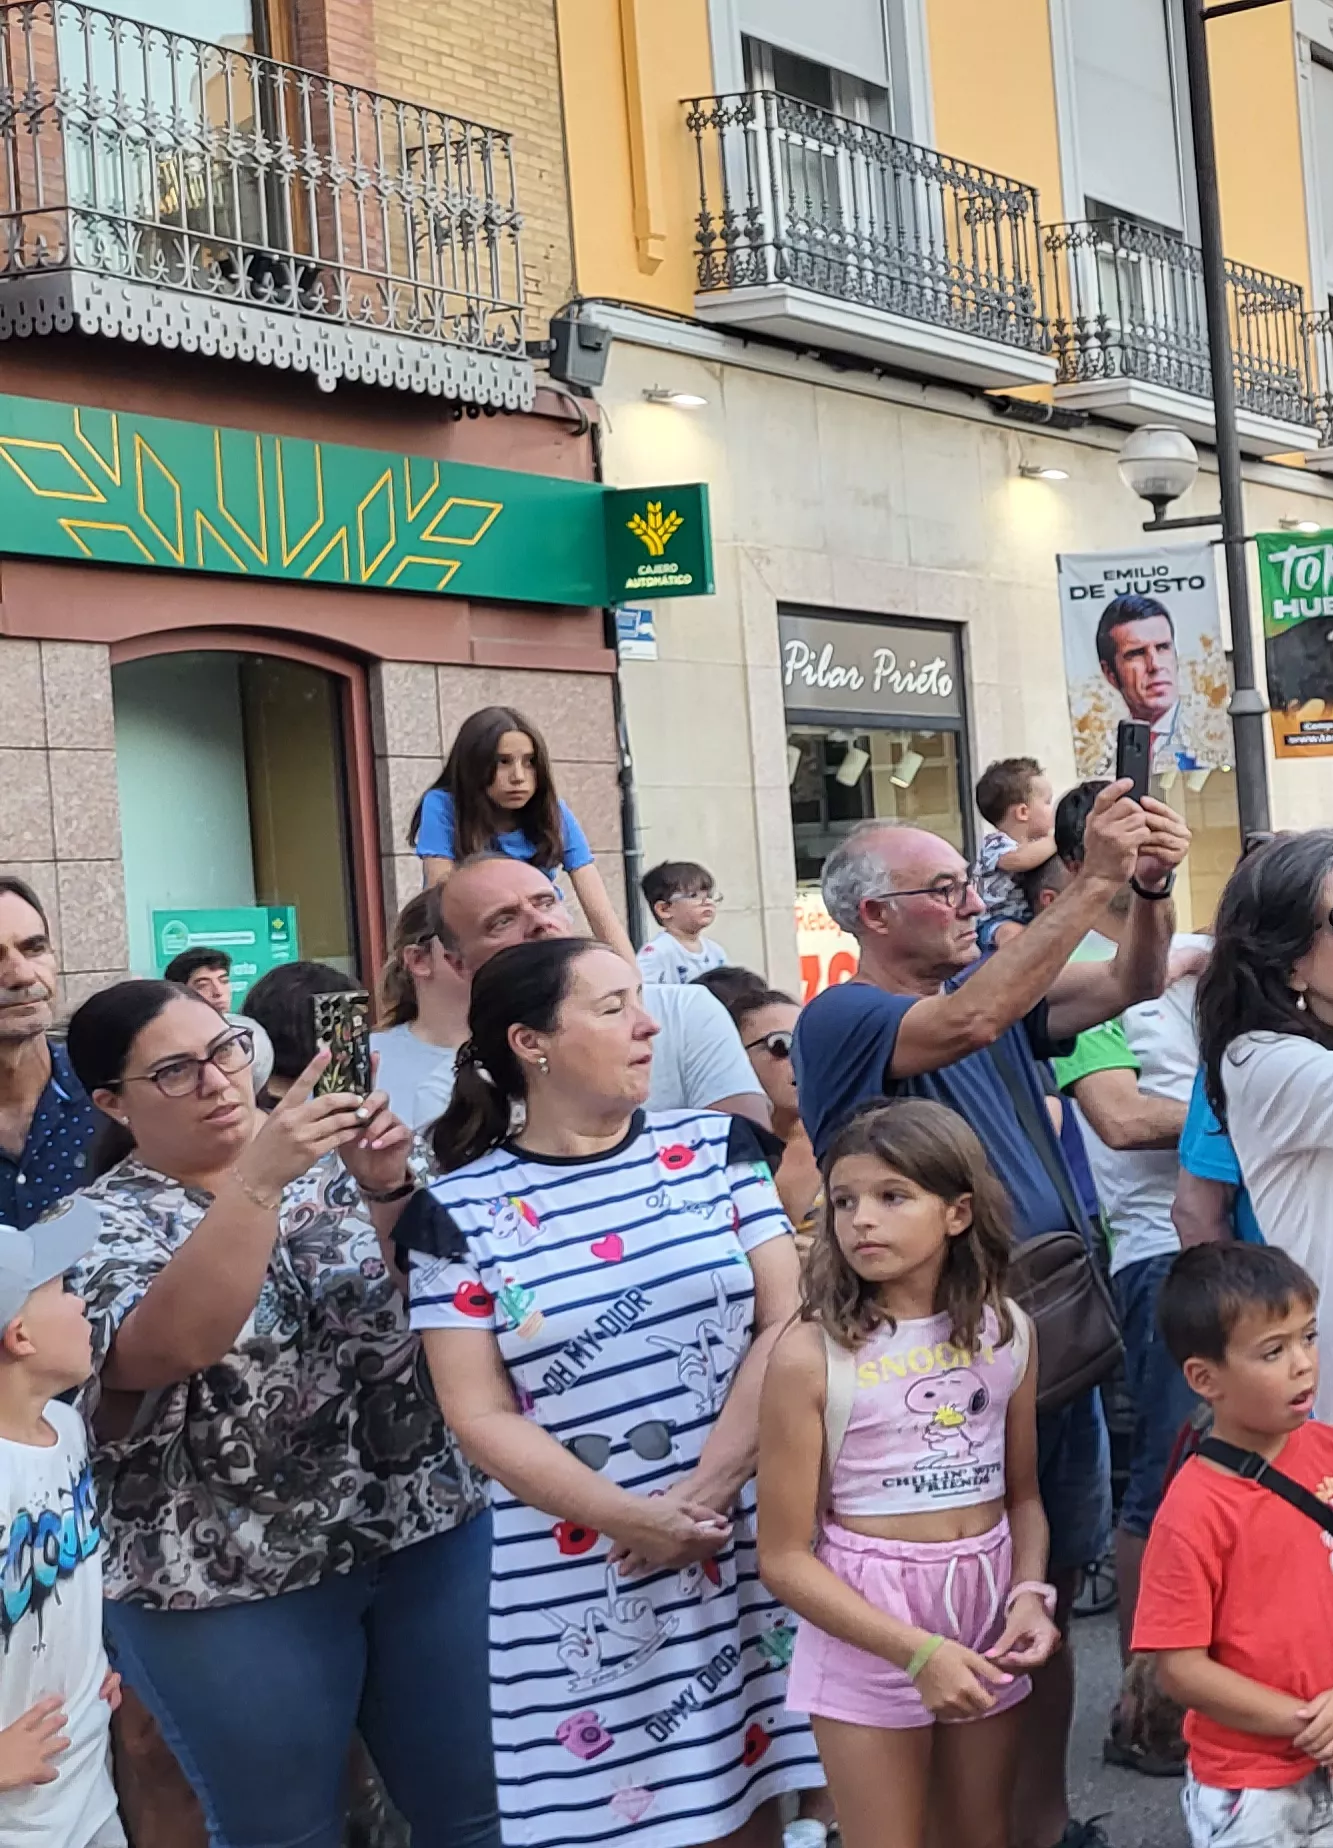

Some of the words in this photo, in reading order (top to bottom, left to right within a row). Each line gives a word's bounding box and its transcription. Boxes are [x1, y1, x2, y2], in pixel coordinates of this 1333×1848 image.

[638, 562, 679, 576] CAJERO
[1069, 583, 1105, 600] DE
[1114, 575, 1206, 597] JUSTO
[1103, 565, 1169, 581] EMILIO
[784, 639, 865, 691] Pilar
[873, 647, 953, 697] Prieto
[542, 1359, 578, 1396] OH
[563, 1328, 603, 1369] MY
[594, 1288, 653, 1338] DIOR
[644, 1707, 681, 1743] OH
[697, 1643, 742, 1694] DIOR
